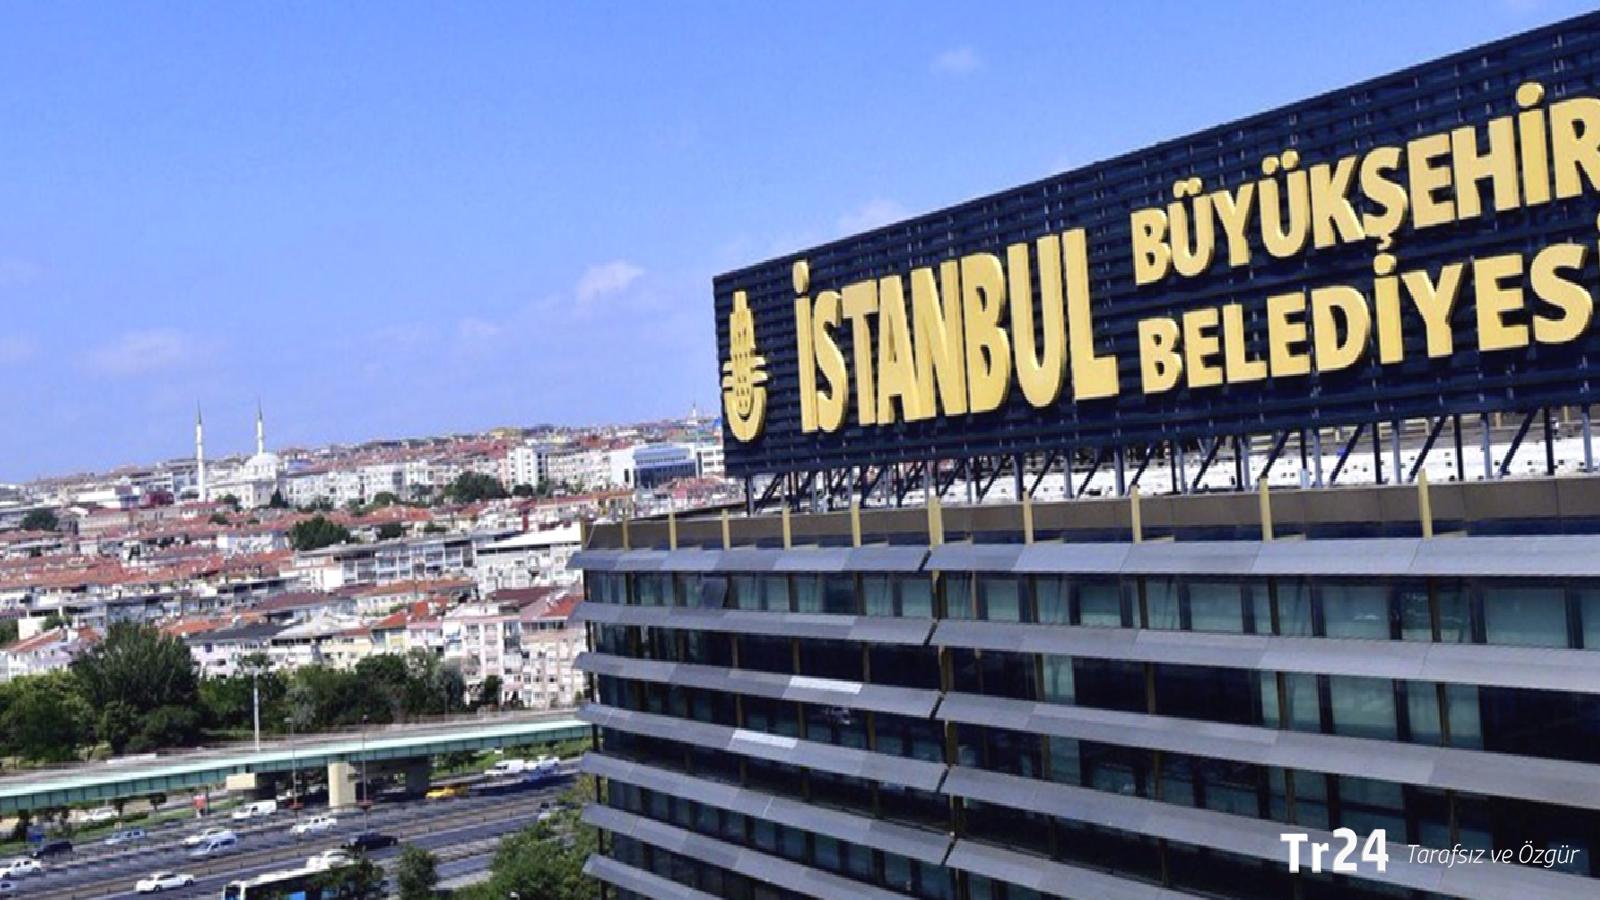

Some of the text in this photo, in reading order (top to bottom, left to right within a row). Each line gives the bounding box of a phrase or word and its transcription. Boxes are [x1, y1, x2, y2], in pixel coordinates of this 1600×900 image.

[1130, 81, 1600, 286] BÜYÜKŞEHİR
[792, 227, 1120, 434] İSTANBUL
[1137, 212, 1600, 395] BELEDİYES
